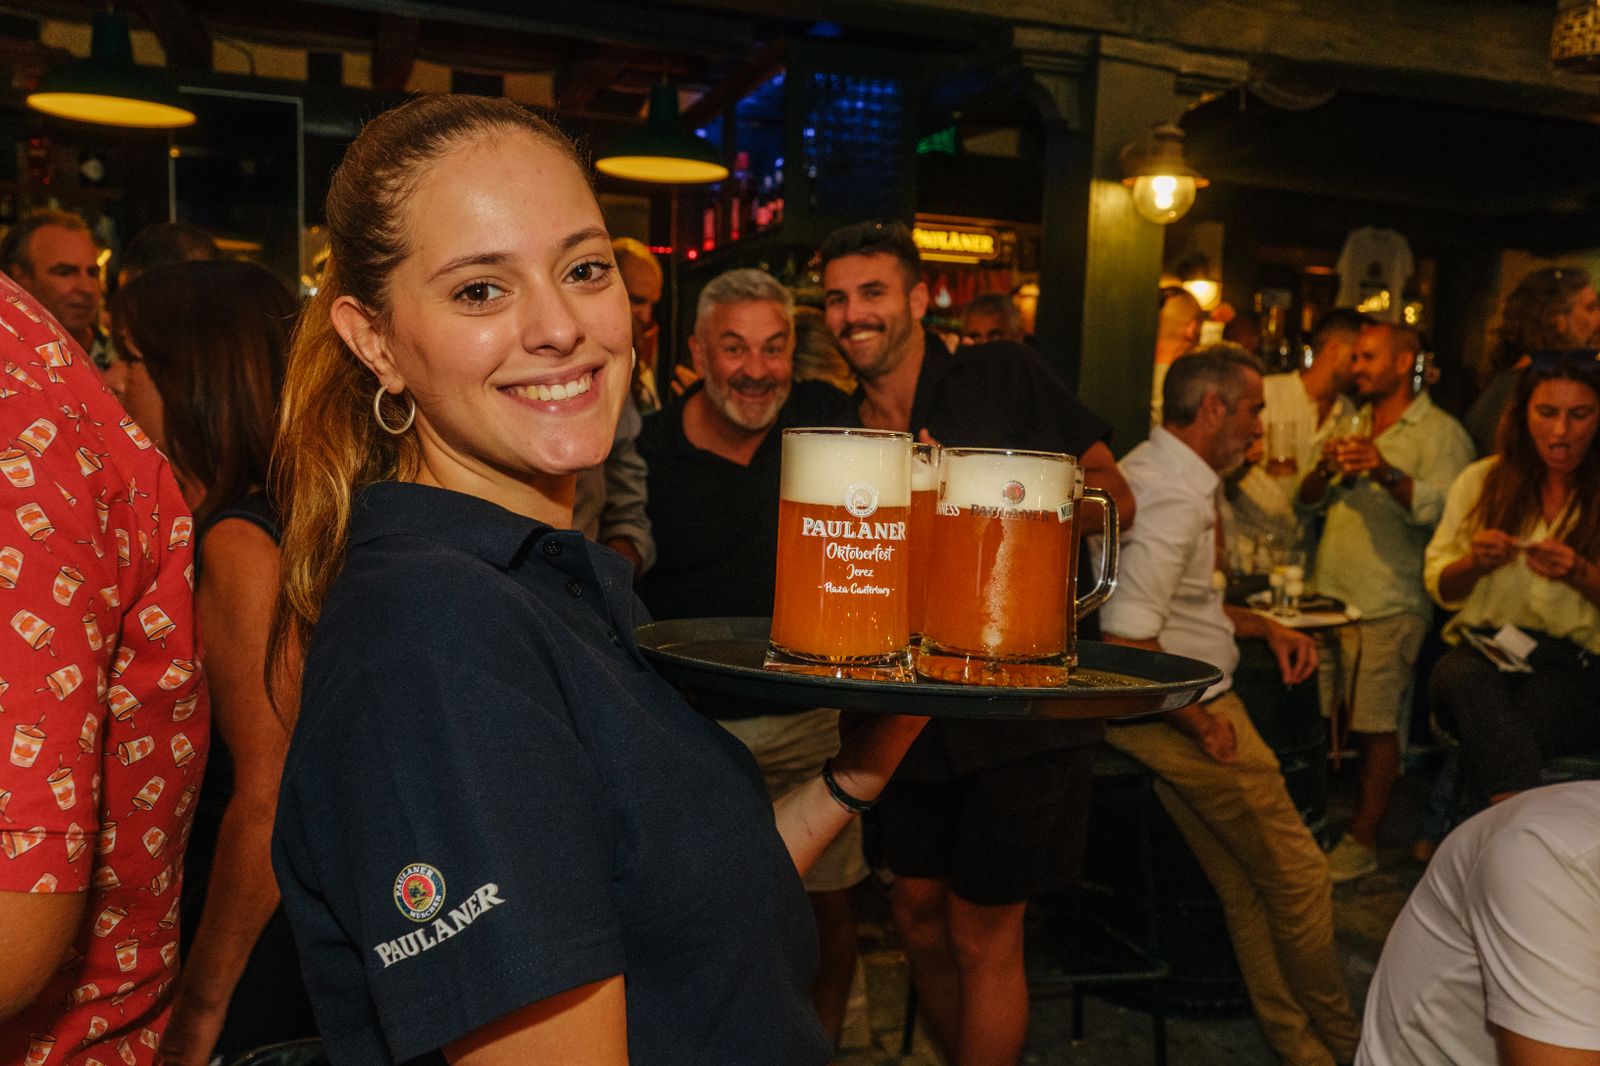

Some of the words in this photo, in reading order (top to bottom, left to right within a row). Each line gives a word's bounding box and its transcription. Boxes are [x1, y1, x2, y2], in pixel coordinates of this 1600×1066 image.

[802, 517, 905, 541] PAULANER
[826, 542, 895, 562] Oktoberfest
[846, 563, 874, 579] Jerez
[396, 866, 434, 896] PAULANER
[373, 882, 506, 968] PAULANER
